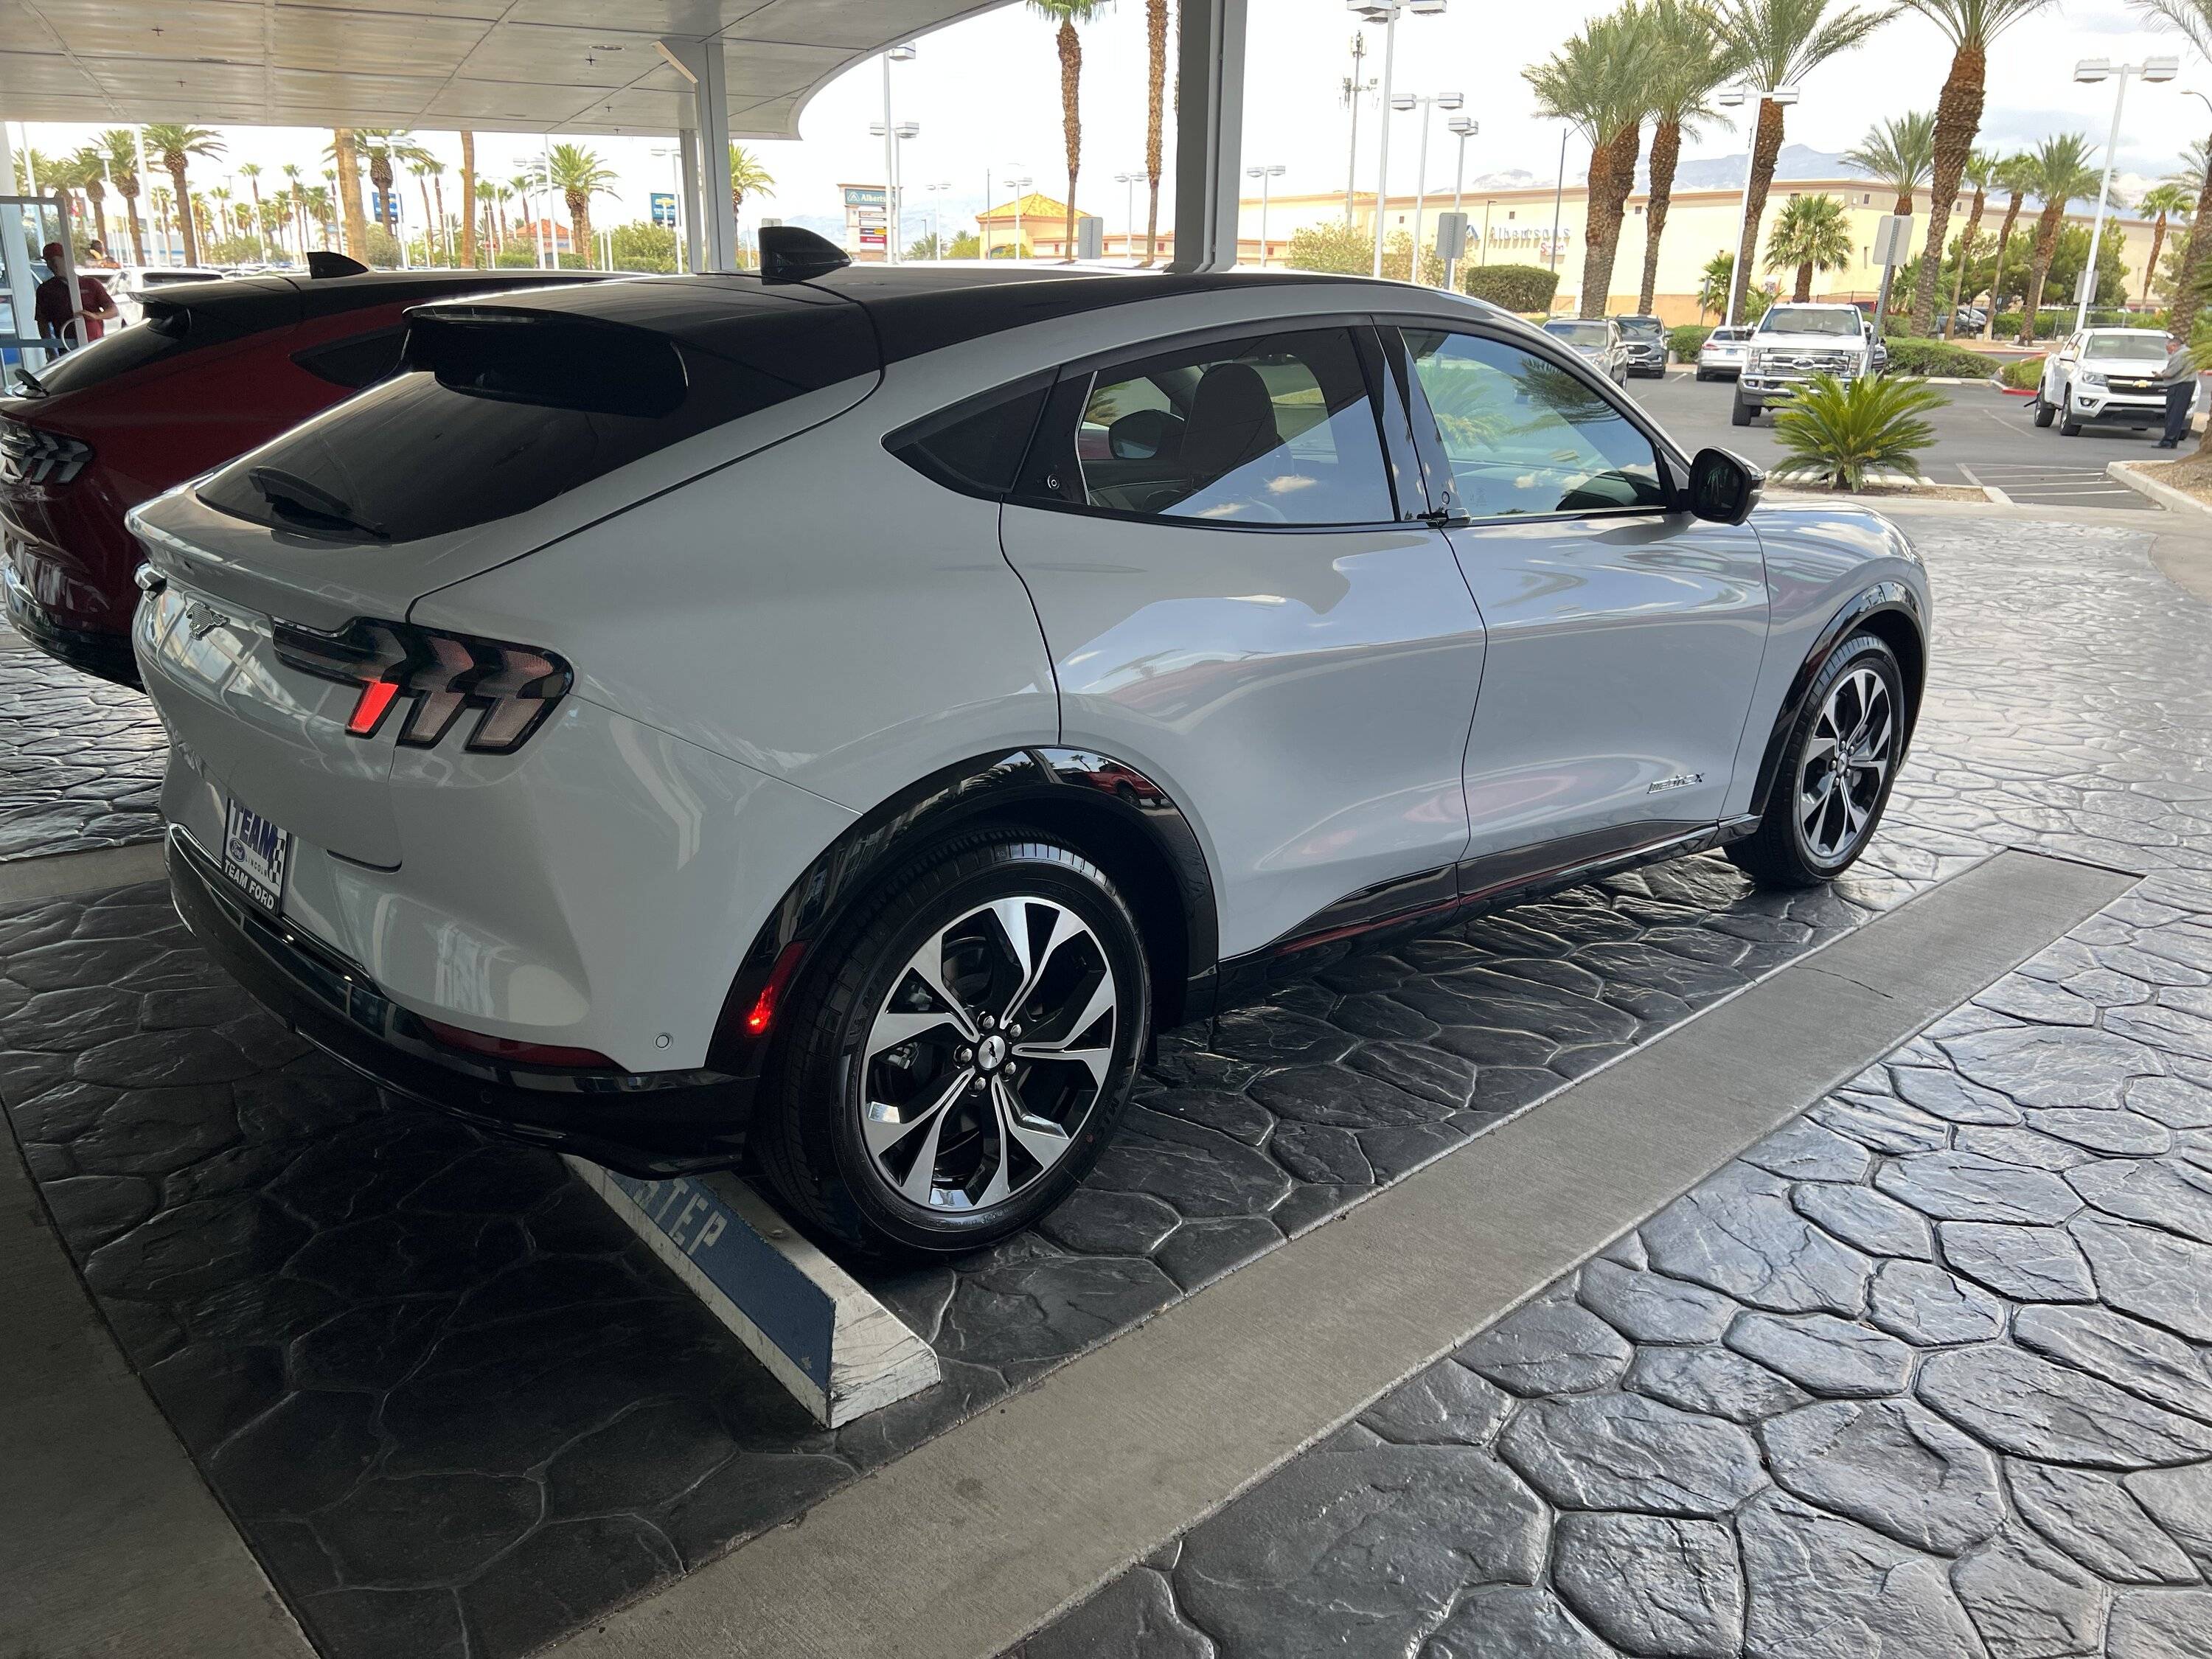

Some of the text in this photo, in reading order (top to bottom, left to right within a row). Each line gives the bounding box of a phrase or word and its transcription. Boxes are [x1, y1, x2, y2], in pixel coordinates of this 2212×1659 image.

[1488, 226, 1571, 242] Albertsos
[232, 801, 278, 861] TEAM
[224, 859, 275, 911] TEAM FORD
[633, 1178, 728, 1256] STEP
